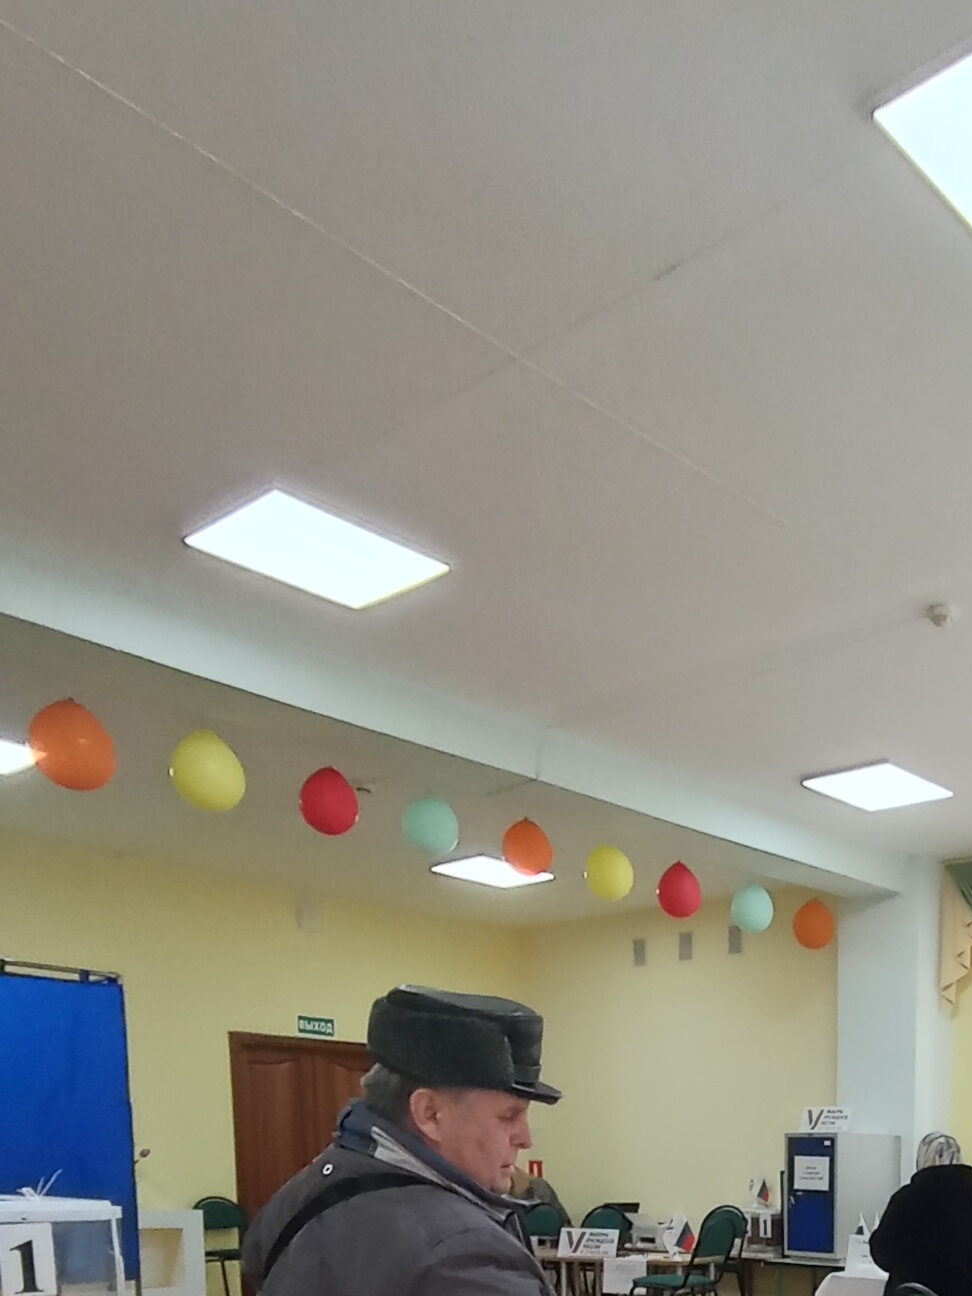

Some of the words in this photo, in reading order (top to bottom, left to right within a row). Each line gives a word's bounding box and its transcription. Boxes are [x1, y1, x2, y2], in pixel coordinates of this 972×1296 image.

[299, 1019, 333, 1034] ВЫХОД
[762, 1218, 768, 1236] 1
[9, 1239, 44, 1294] 1
